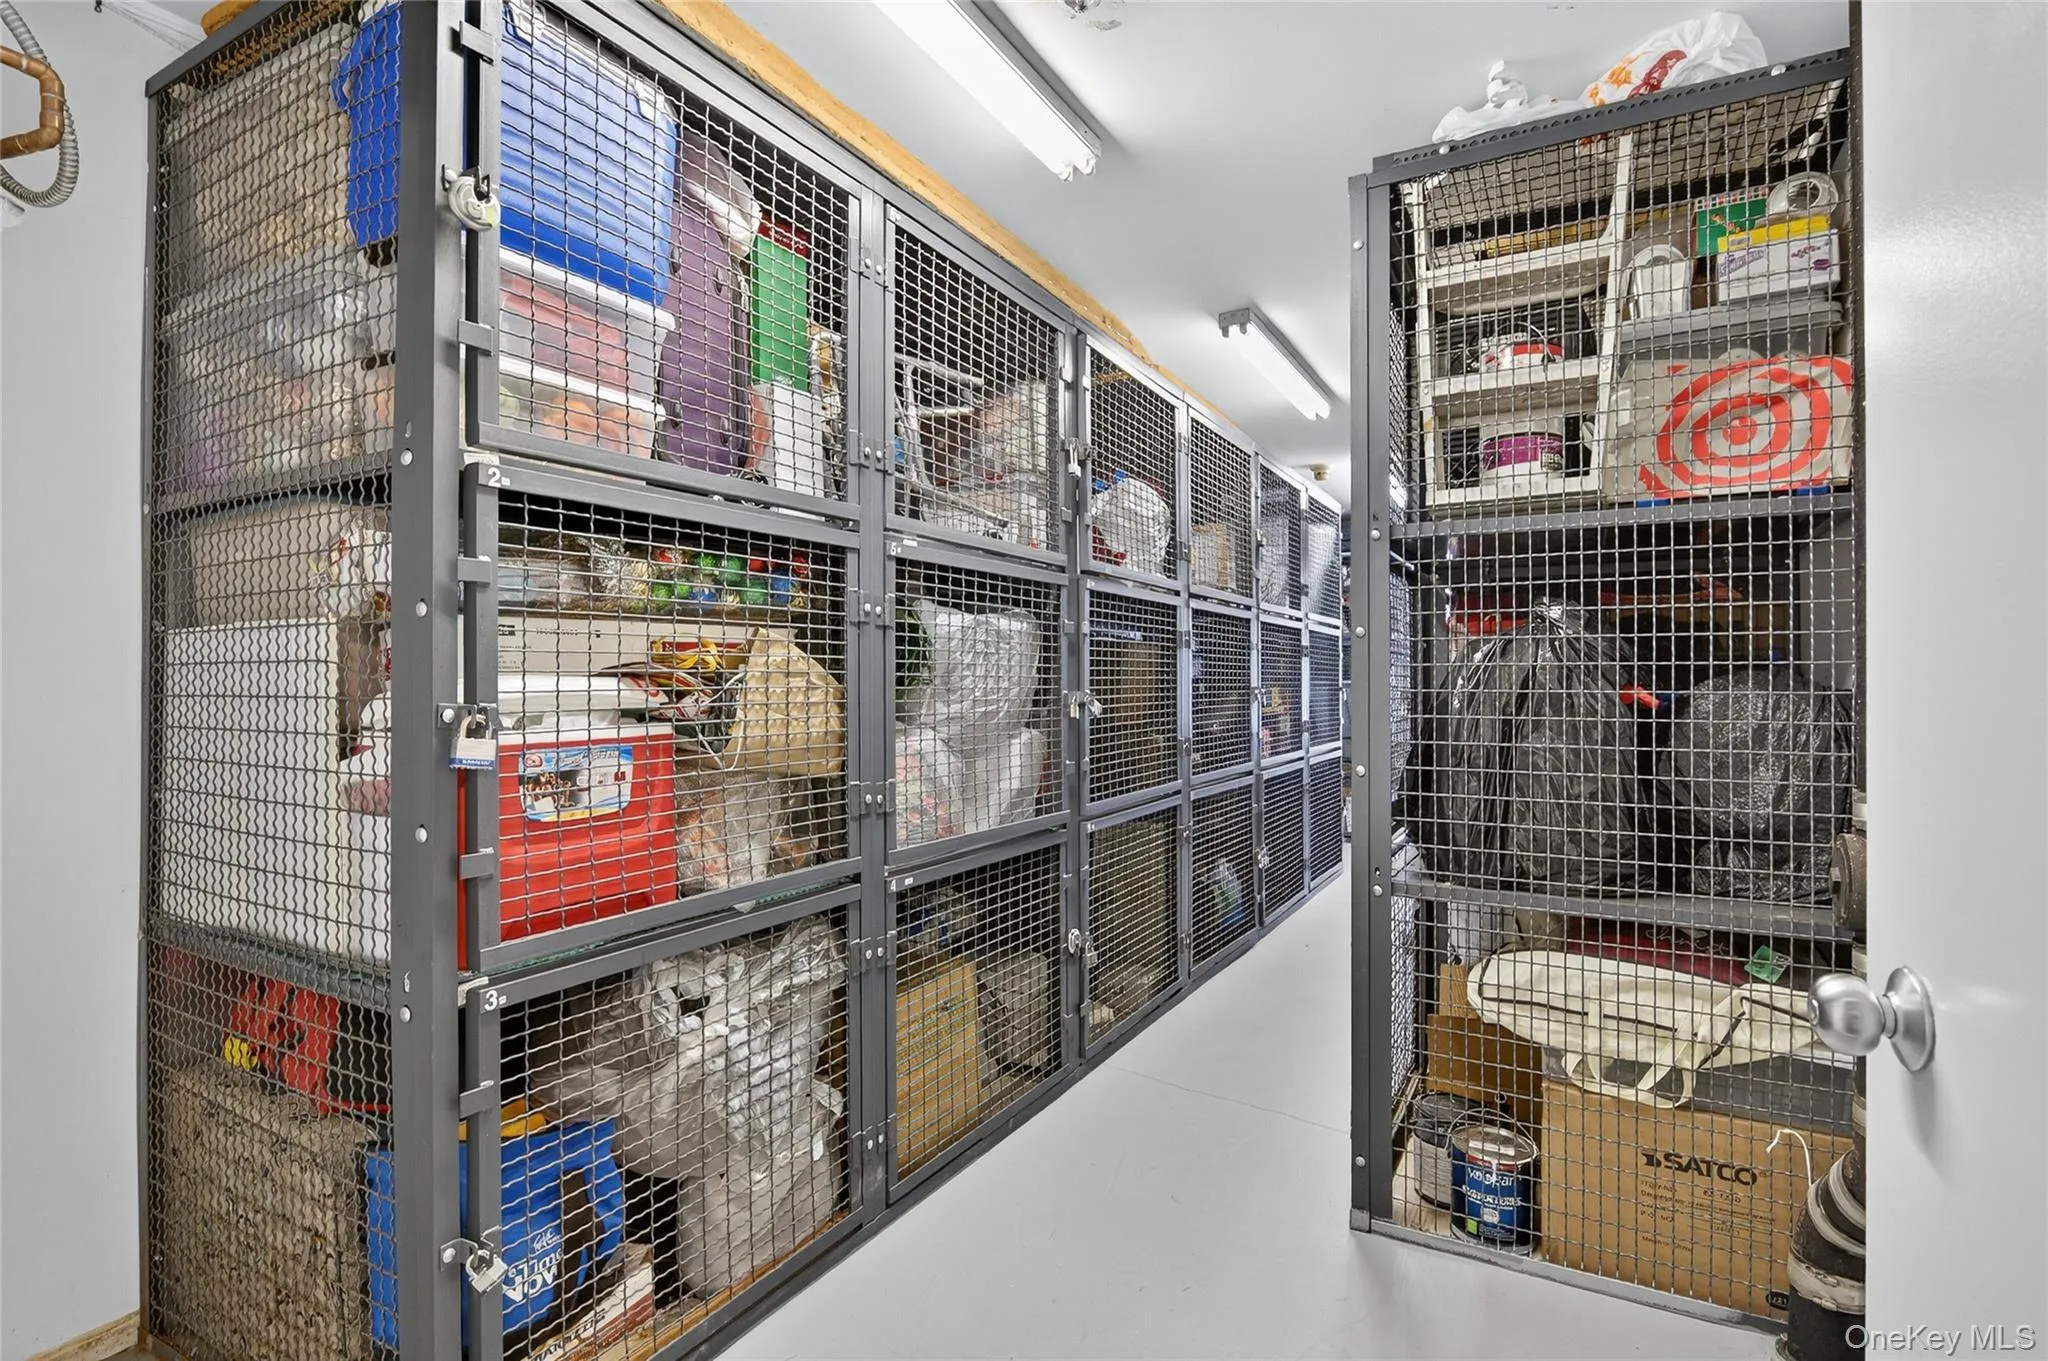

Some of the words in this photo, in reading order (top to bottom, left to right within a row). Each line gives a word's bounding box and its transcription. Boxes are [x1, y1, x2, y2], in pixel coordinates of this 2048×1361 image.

[488, 467, 501, 487] 2
[890, 880, 896, 891] 4
[484, 990, 499, 1011] 3
[1663, 1152, 1758, 1186] SATCO
